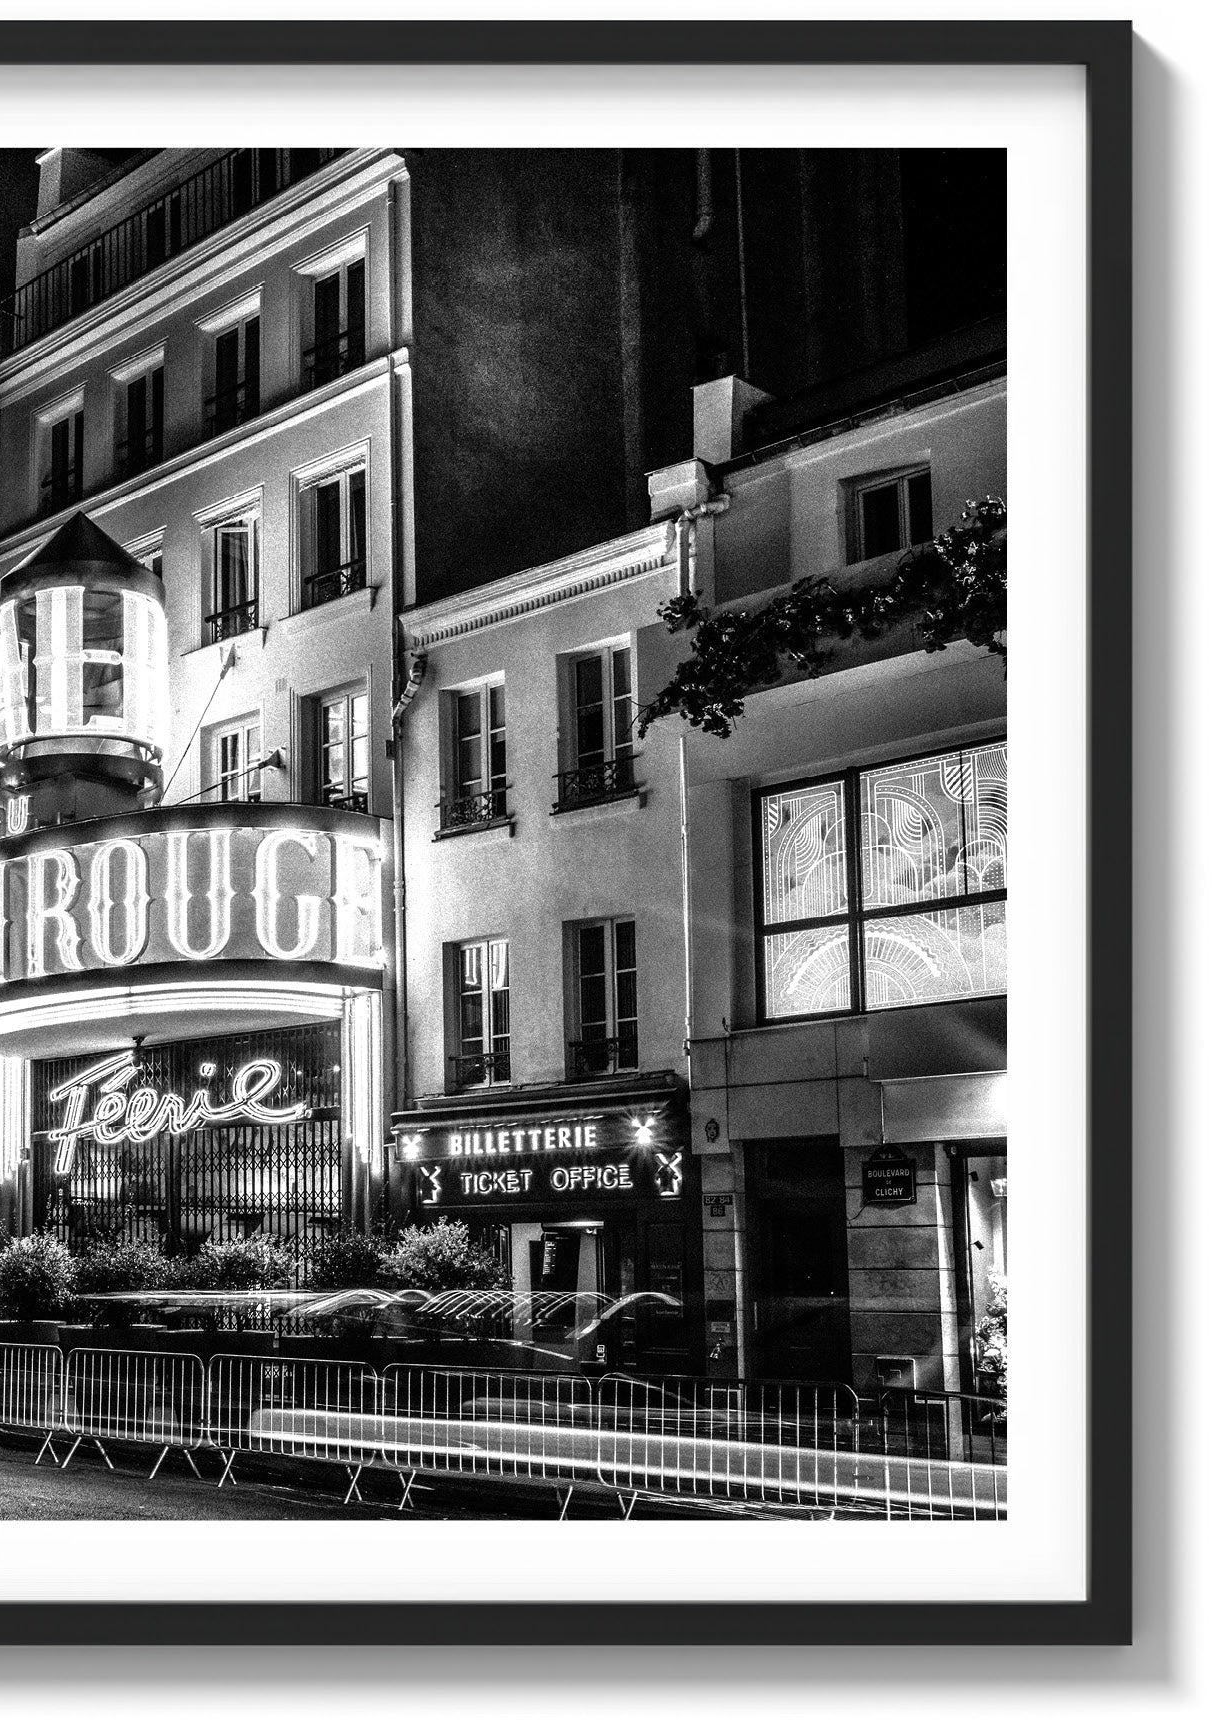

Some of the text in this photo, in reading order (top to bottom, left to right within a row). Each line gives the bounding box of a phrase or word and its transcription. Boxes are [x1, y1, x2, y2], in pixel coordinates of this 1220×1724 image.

[27, 828, 384, 979] ROUGE
[48, 1050, 314, 1175] Féerie
[449, 1126, 597, 1156] BILLETTERIE
[460, 1164, 633, 1195] TICKET OFFICE
[867, 1168, 910, 1178] BOULEVARD
[875, 1187, 904, 1197] CLICHY
